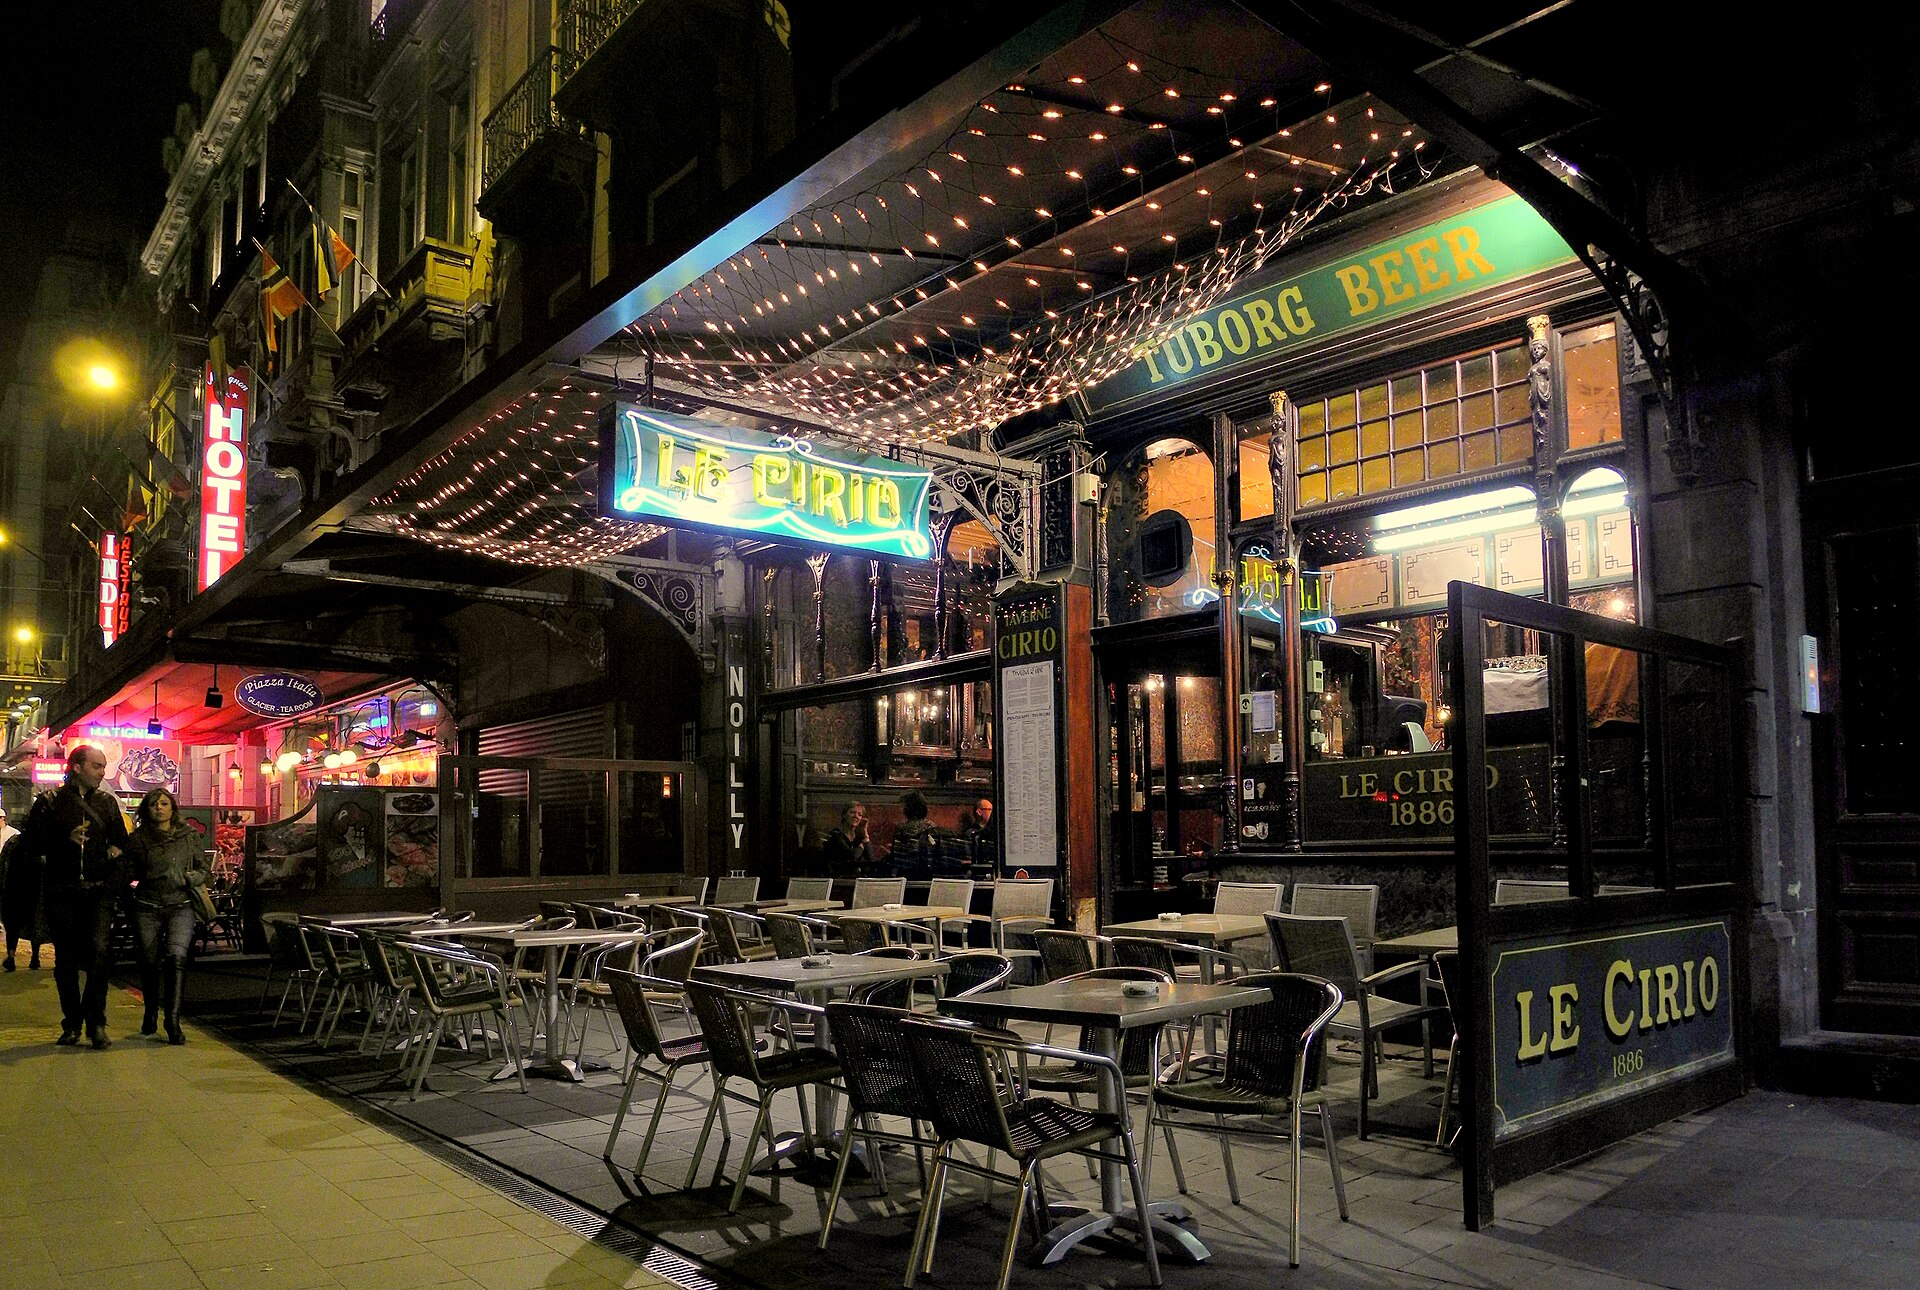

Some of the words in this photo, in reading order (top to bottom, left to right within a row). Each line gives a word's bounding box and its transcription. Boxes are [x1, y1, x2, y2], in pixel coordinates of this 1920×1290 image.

[1132, 286, 1316, 383] TUBORG
[1335, 225, 1496, 317] BEER
[752, 453, 902, 529] CIRIO
[1004, 606, 1052, 627] TAVERNE
[998, 626, 1057, 660] CIRIO
[244, 678, 284, 694] Piazza
[286, 678, 317, 698] Italia
[247, 696, 276, 712] GLACIER
[281, 705, 294, 713] TEA
[295, 700, 314, 712] ROOM
[729, 665, 744, 849] NOILLY
[1339, 773, 1379, 798] LE
[1390, 800, 1455, 826] 1886
[1516, 983, 1581, 1061] LE
[1604, 956, 1719, 1037] CIRIO
[1612, 1049, 1644, 1078] 1886
